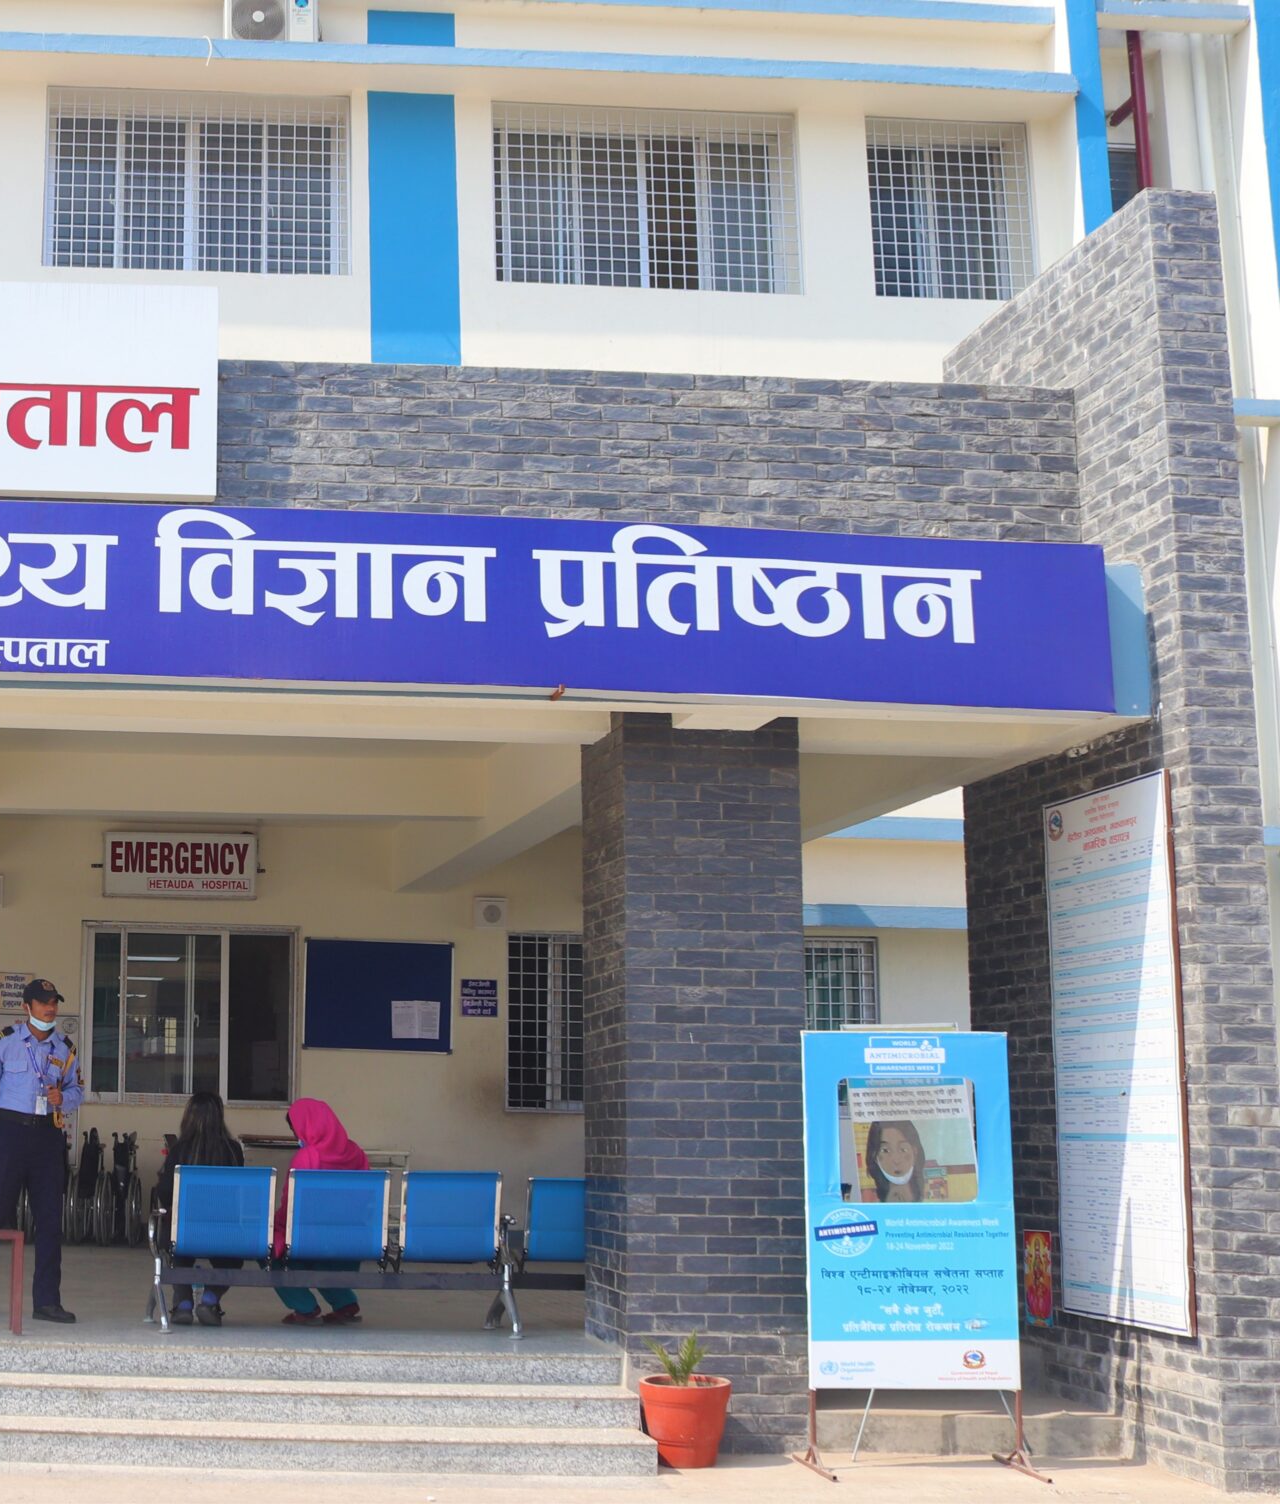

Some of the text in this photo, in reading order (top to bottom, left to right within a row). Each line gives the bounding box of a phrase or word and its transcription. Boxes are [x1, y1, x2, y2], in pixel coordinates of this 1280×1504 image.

[154, 508, 496, 626] विज्ञान
[531, 524, 982, 645] प्रतिष्ठान
[110, 841, 249, 875] EMERGENCY
[149, 879, 249, 890] HETAUDA HOSPITAL
[885, 1218, 999, 1226] World Antimicrobial Awareness Week
[819, 1224, 875, 1236] ANTIMICROBIALS
[885, 1231, 914, 1239] Preventing
[985, 1231, 1009, 1239] Together
[886, 1242, 954, 1250] 18-24 November 2022
[821, 1268, 845, 1279] विश्व
[934, 1268, 969, 1279] सचेतना
[974, 1269, 1004, 1279] सप्ताह
[857, 1284, 892, 1295] १८-२४
[942, 1285, 969, 1295] २०२२
